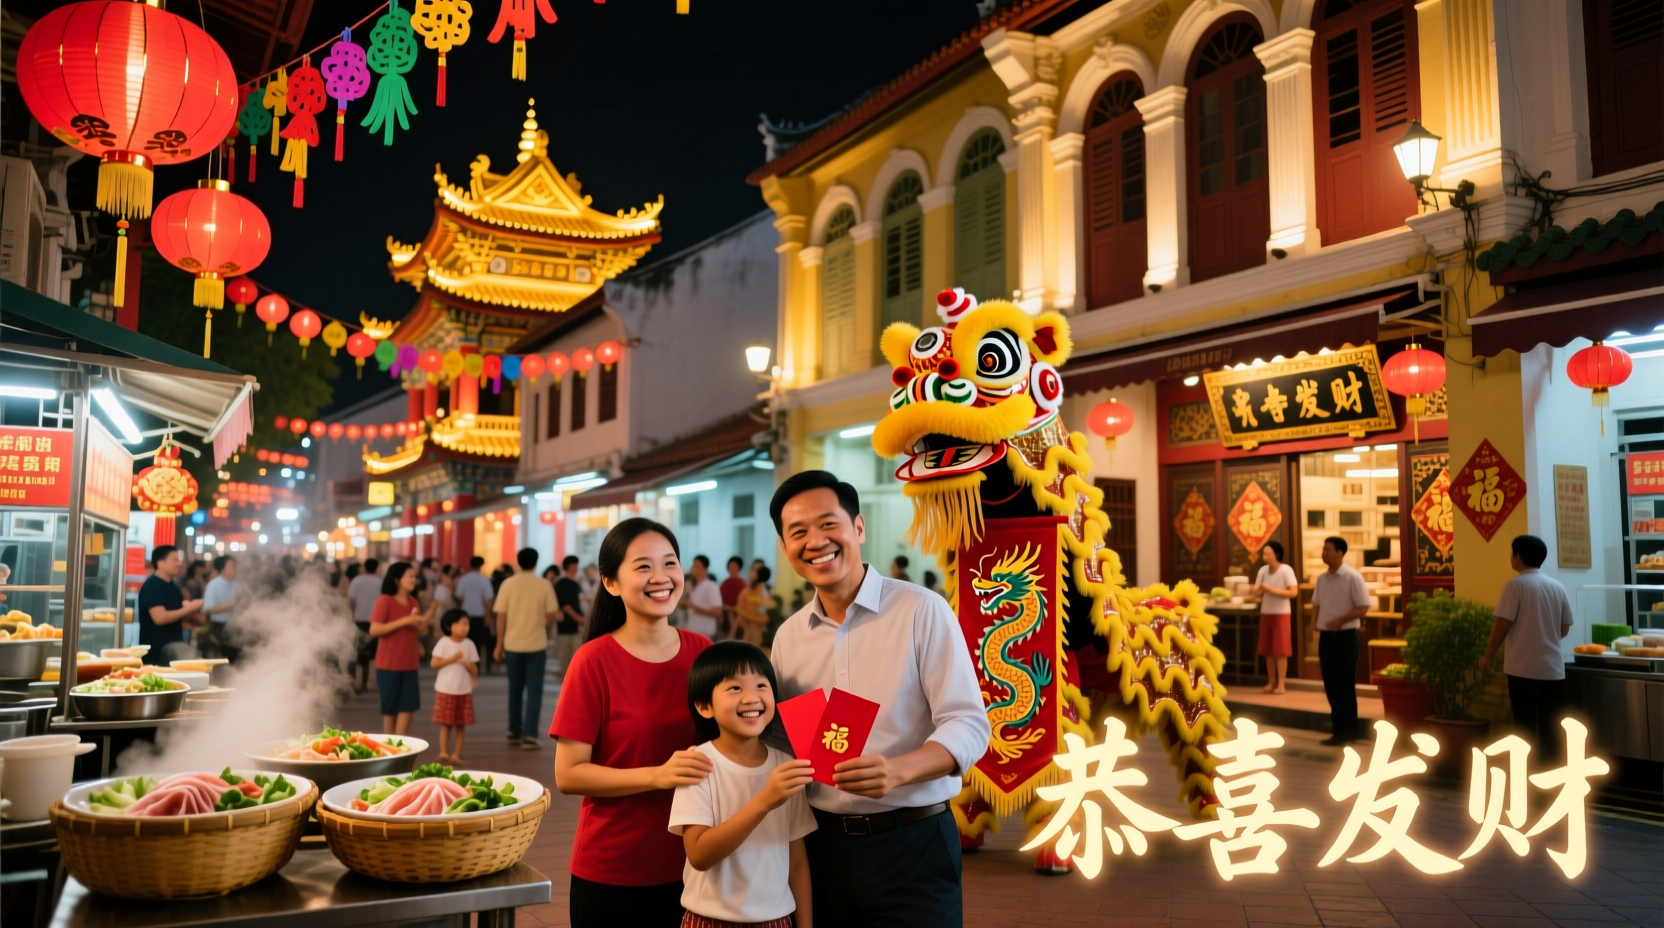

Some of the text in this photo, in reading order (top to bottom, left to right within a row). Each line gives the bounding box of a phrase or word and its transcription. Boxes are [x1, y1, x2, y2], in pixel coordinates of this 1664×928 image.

[1467, 467, 1504, 512] 福
[1238, 501, 1267, 537] 福
[822, 723, 848, 753] 福
